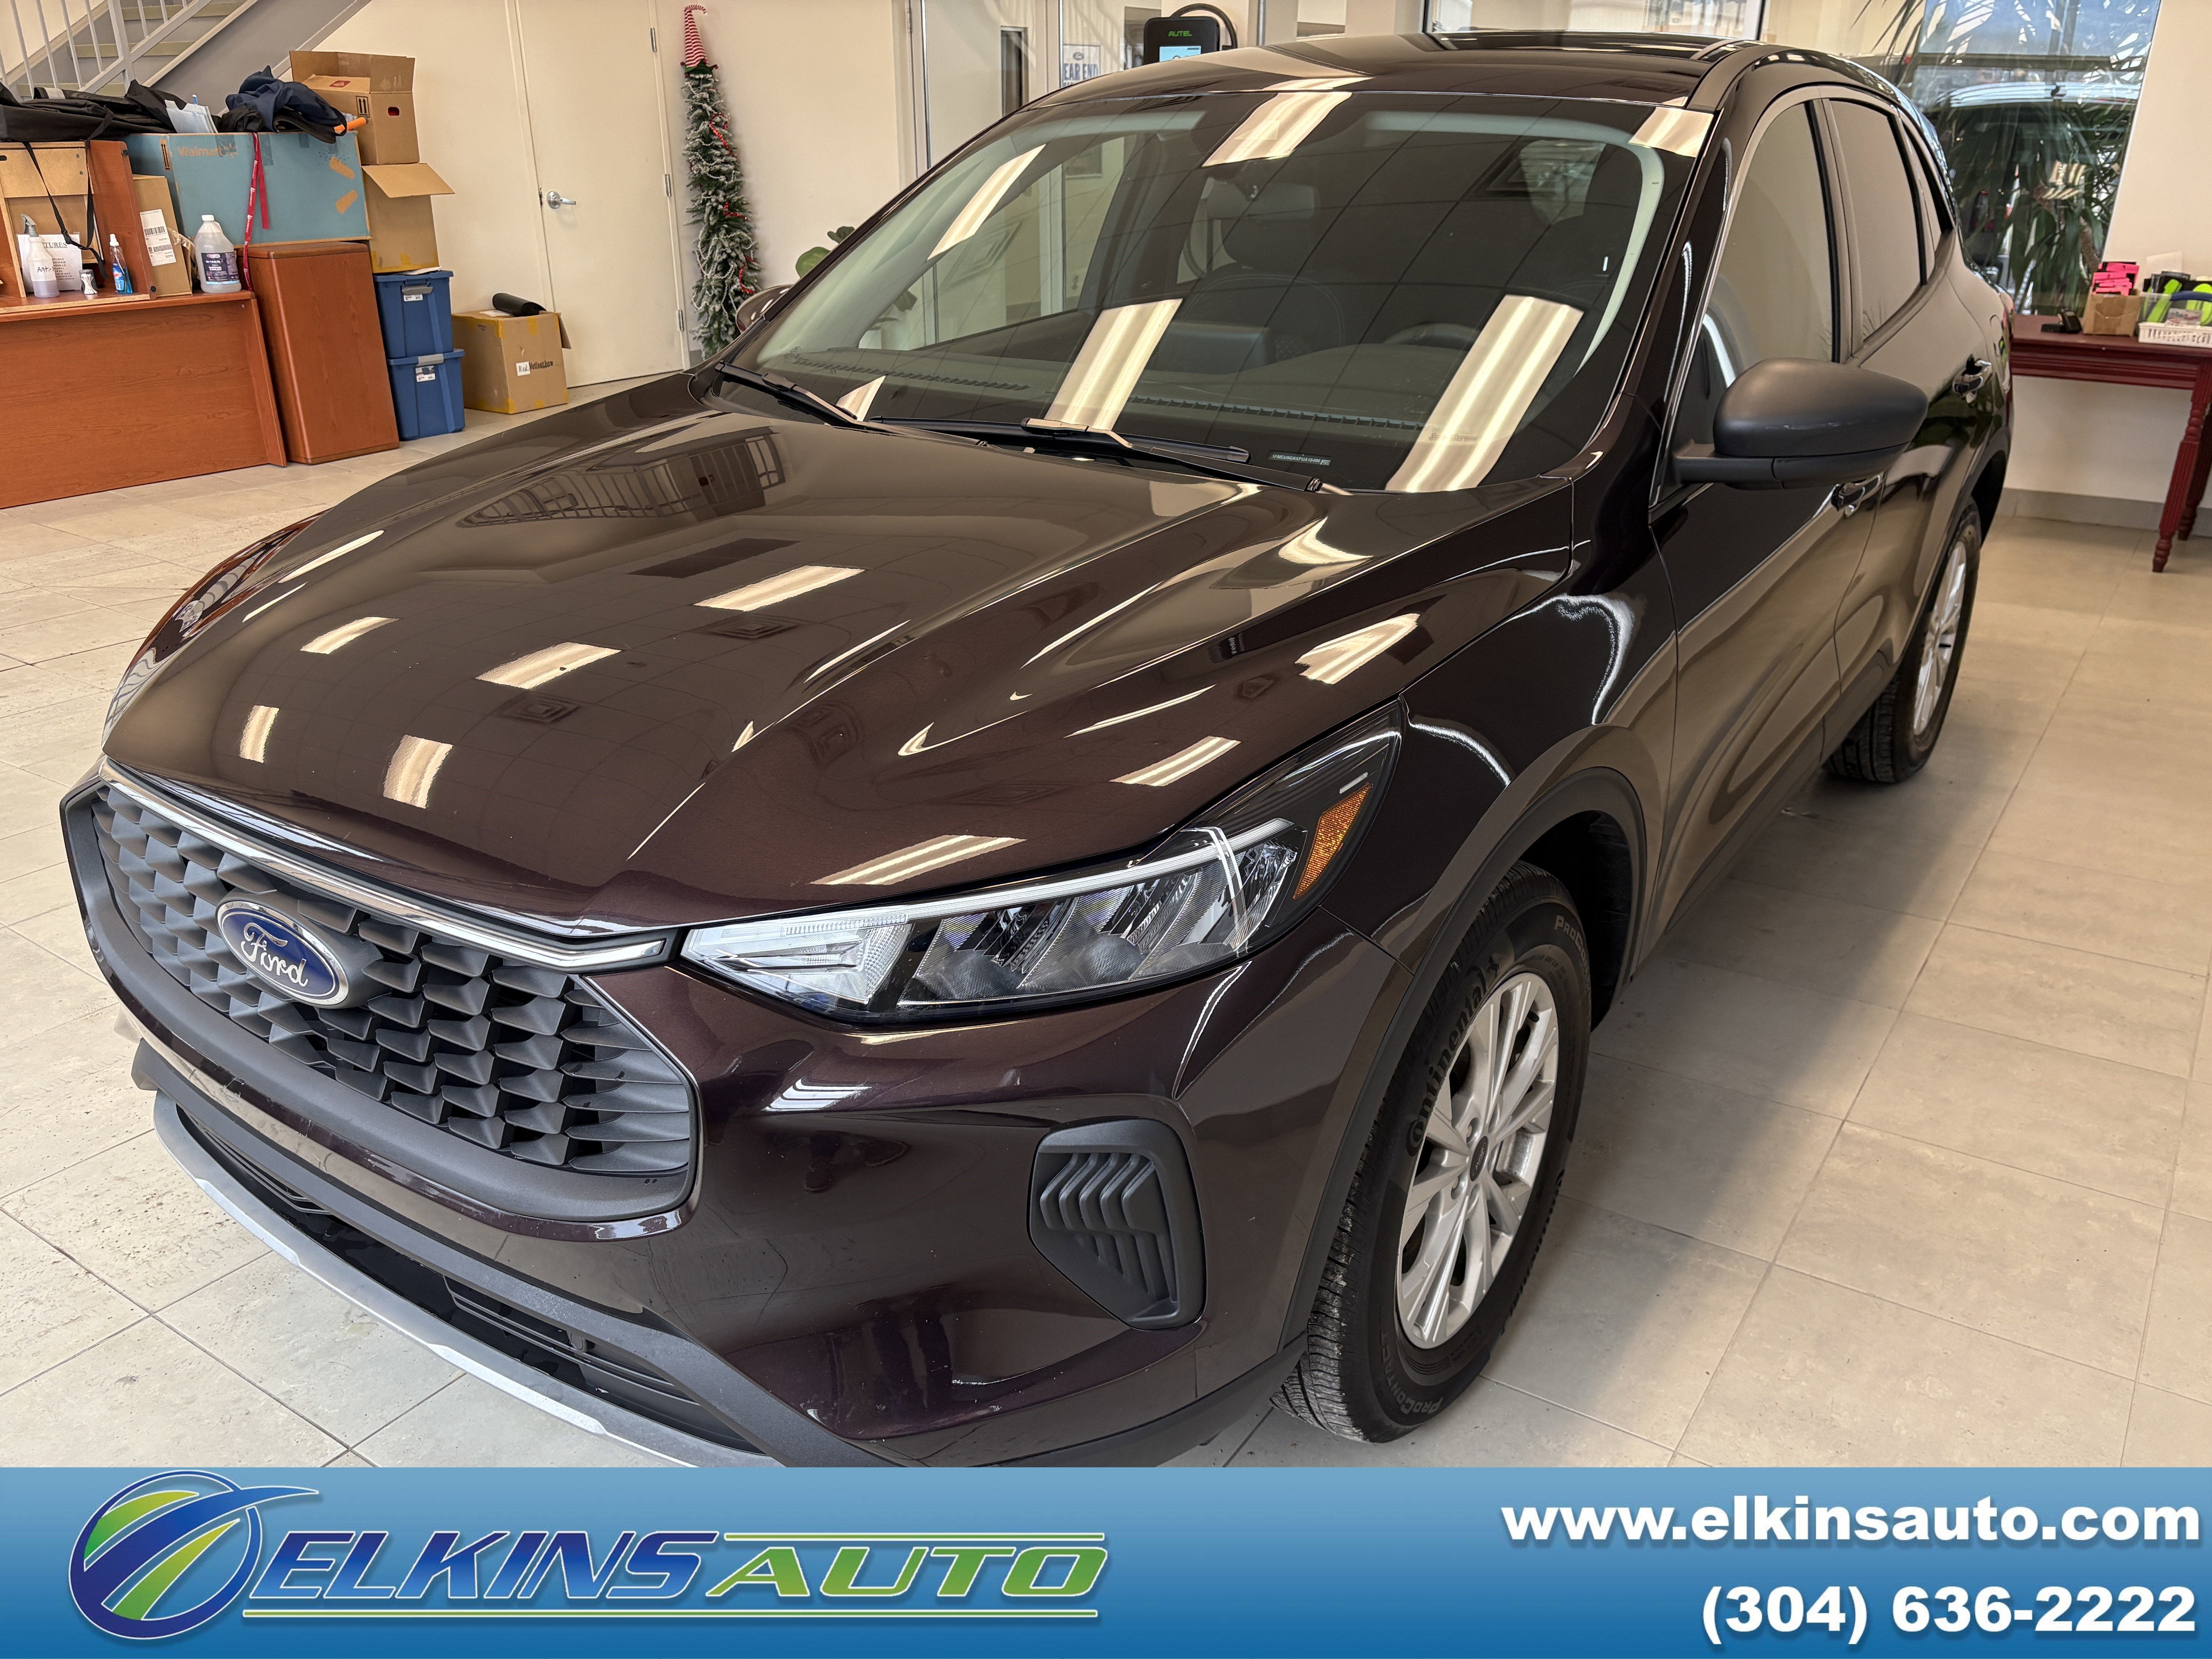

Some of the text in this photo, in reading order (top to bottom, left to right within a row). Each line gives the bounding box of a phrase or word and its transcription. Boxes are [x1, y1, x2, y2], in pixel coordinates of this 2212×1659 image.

[1064, 63, 1099, 81] EAR END
[177, 146, 223, 157] Walmart
[240, 922, 308, 987] Ford
[1405, 964, 1489, 1157] Continental
